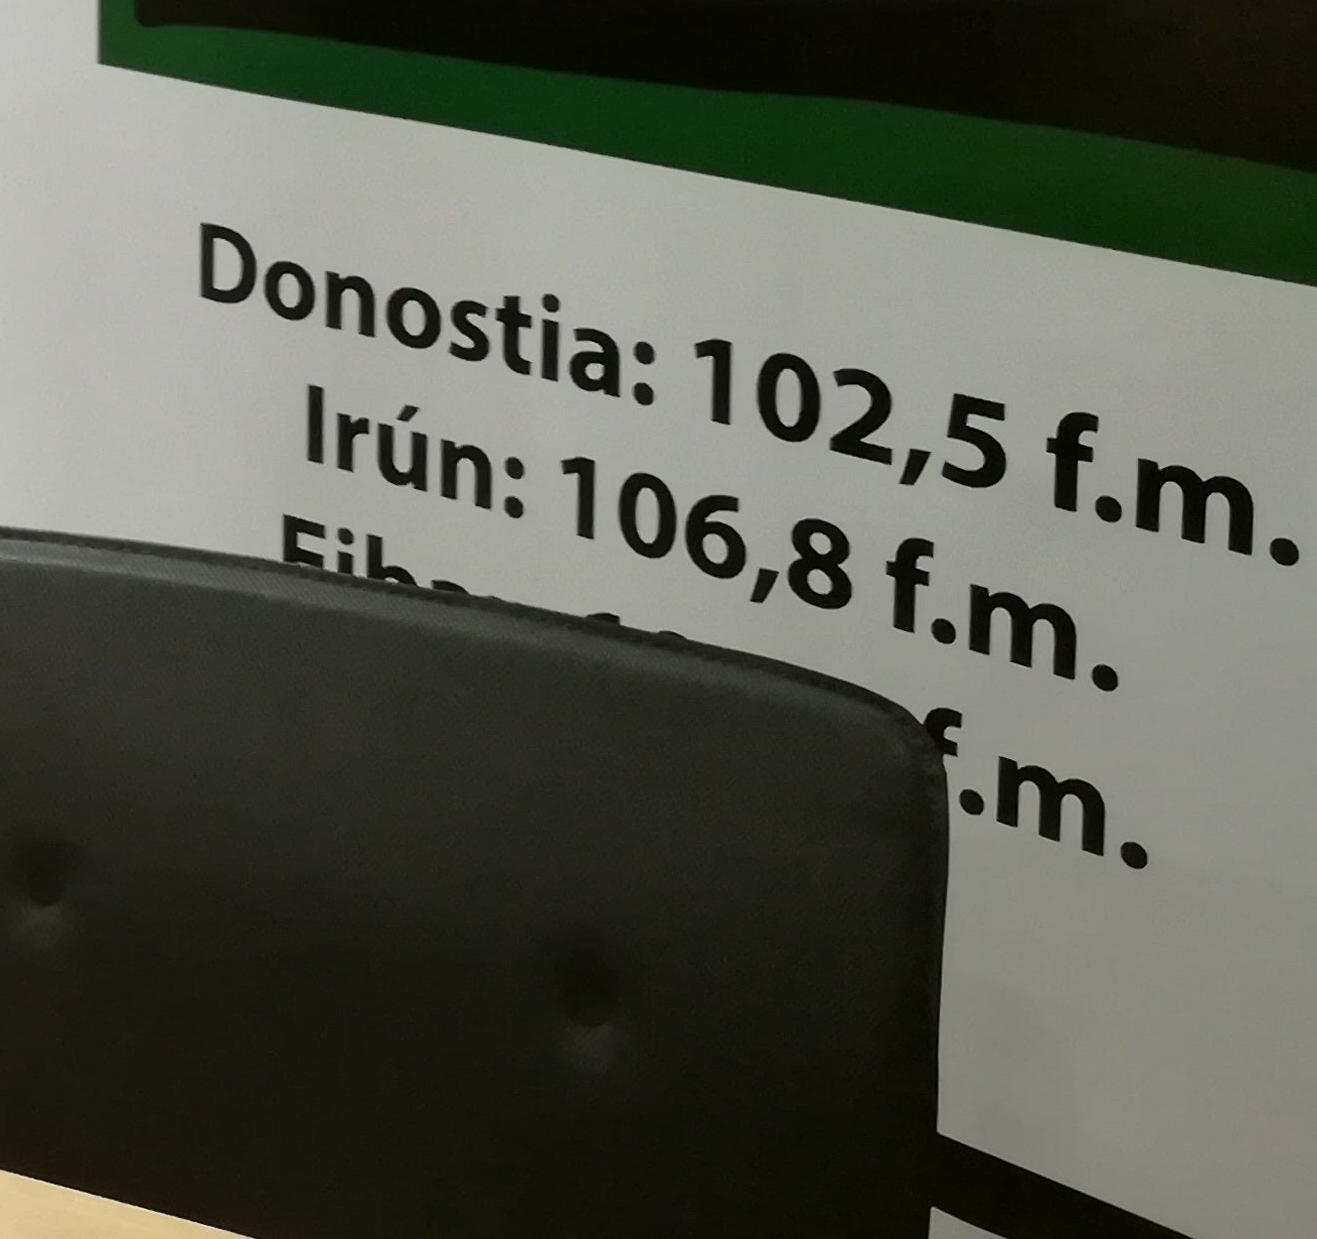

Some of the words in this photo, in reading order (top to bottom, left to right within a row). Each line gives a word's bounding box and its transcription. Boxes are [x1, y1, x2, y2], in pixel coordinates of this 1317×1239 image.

[200, 223, 655, 406] Donostia:
[694, 339, 1007, 489] 102,5
[1045, 411, 1300, 567] f.m.
[307, 385, 525, 519] Irún:
[561, 456, 853, 610] 106,8
[885, 537, 1119, 692] f.m.
